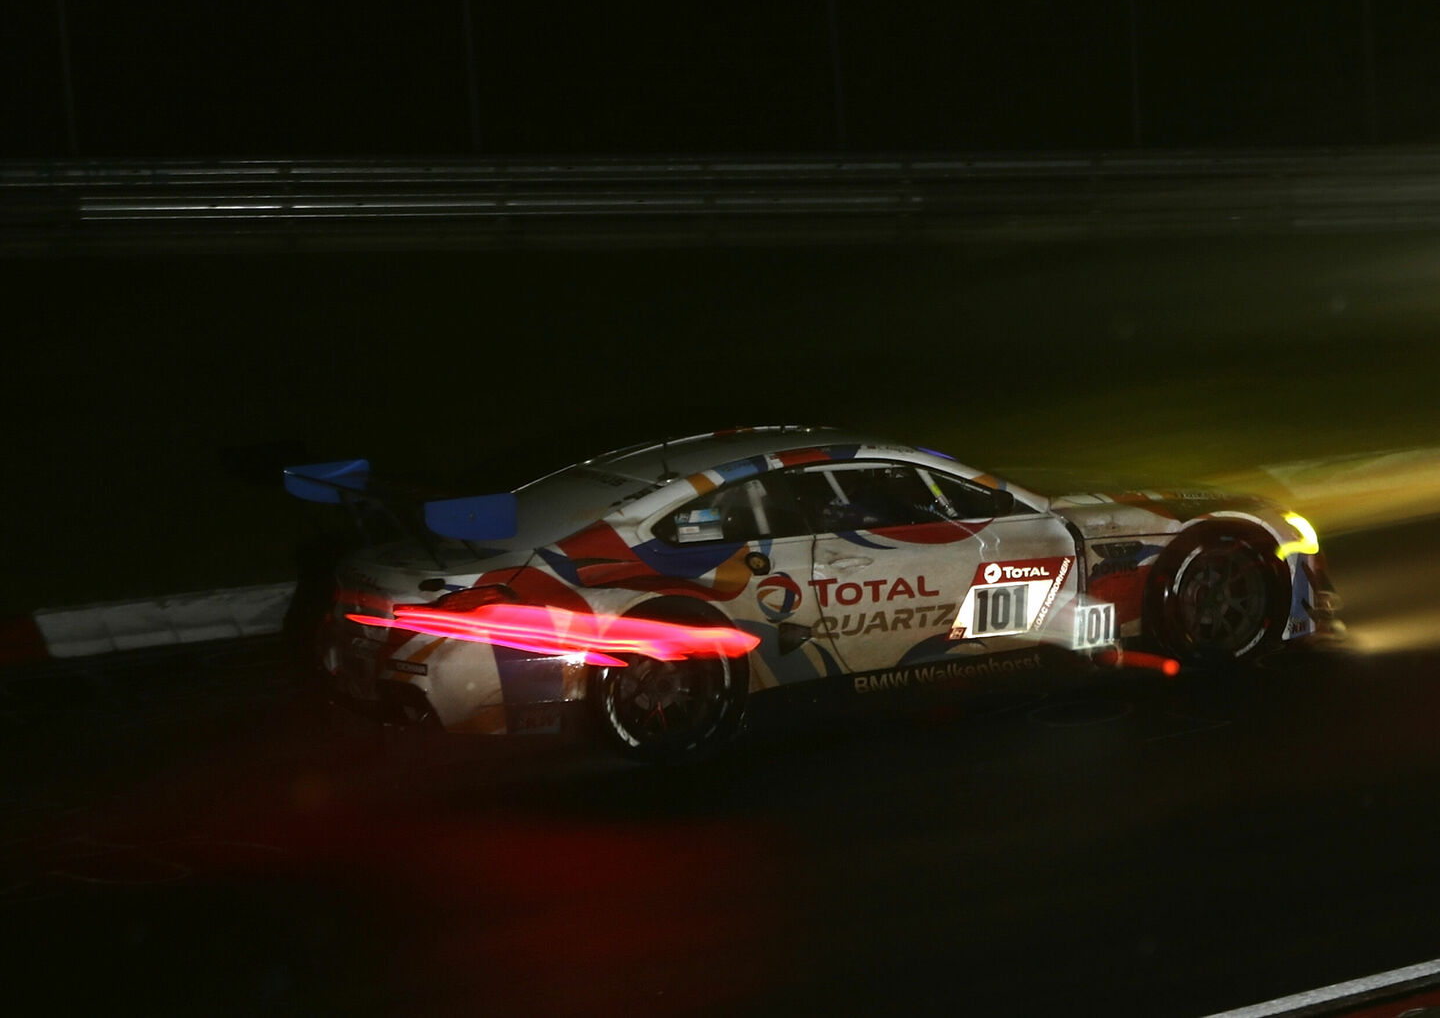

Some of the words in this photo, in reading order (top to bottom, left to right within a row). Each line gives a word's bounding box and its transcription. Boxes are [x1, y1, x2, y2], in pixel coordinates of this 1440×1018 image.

[808, 575, 940, 608] TOTAL
[1002, 566, 1050, 580] TOTAL
[1045, 557, 1072, 608] NORDRHEIN
[811, 603, 957, 640] QUARTZ
[977, 586, 1027, 633] 101
[1077, 605, 1113, 646] 101
[853, 669, 911, 695] BMW
[915, 653, 1042, 685] Walkenhorst
